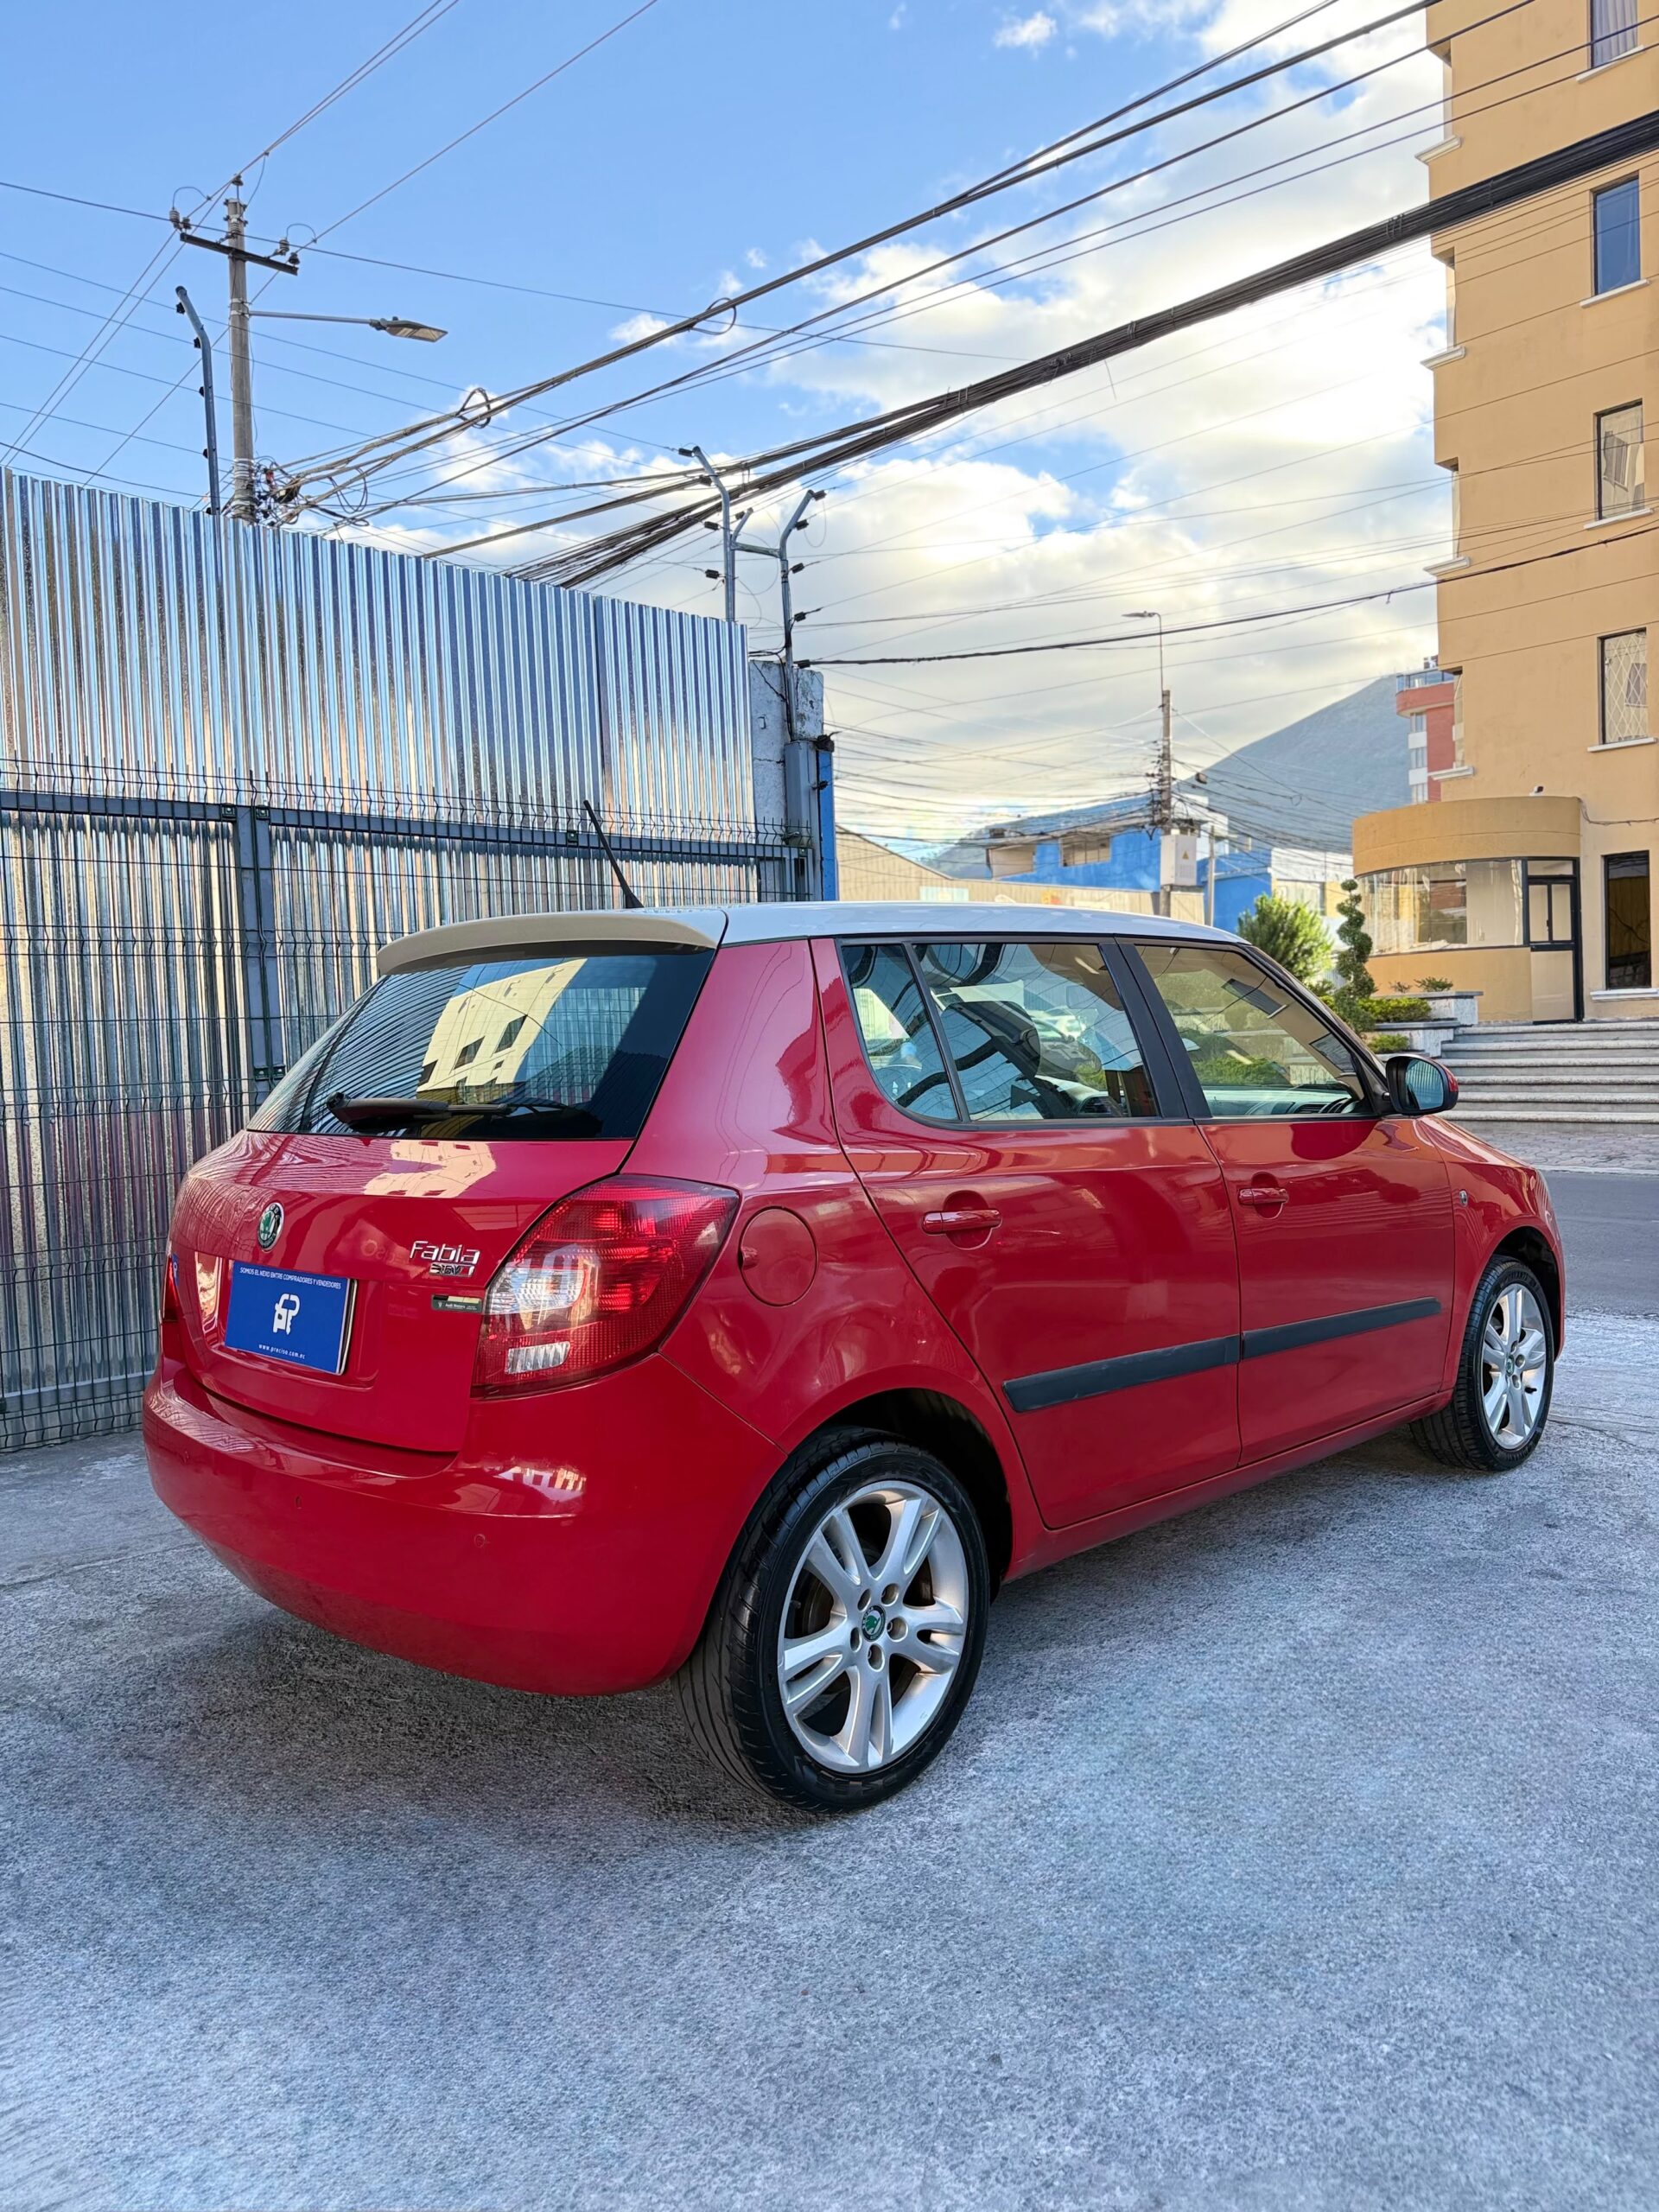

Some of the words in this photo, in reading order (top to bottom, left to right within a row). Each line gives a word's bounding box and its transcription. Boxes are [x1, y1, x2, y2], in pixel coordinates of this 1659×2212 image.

[410, 1240, 480, 1265] Fabia
[240, 1267, 255, 1275] SOMOS
[270, 1271, 283, 1280] ENTRE
[283, 1274, 313, 1285] COMPRADORES
[315, 1280, 341, 1289] VENDEDORES
[258, 1344, 306, 1359] www.preciso.com.ec
